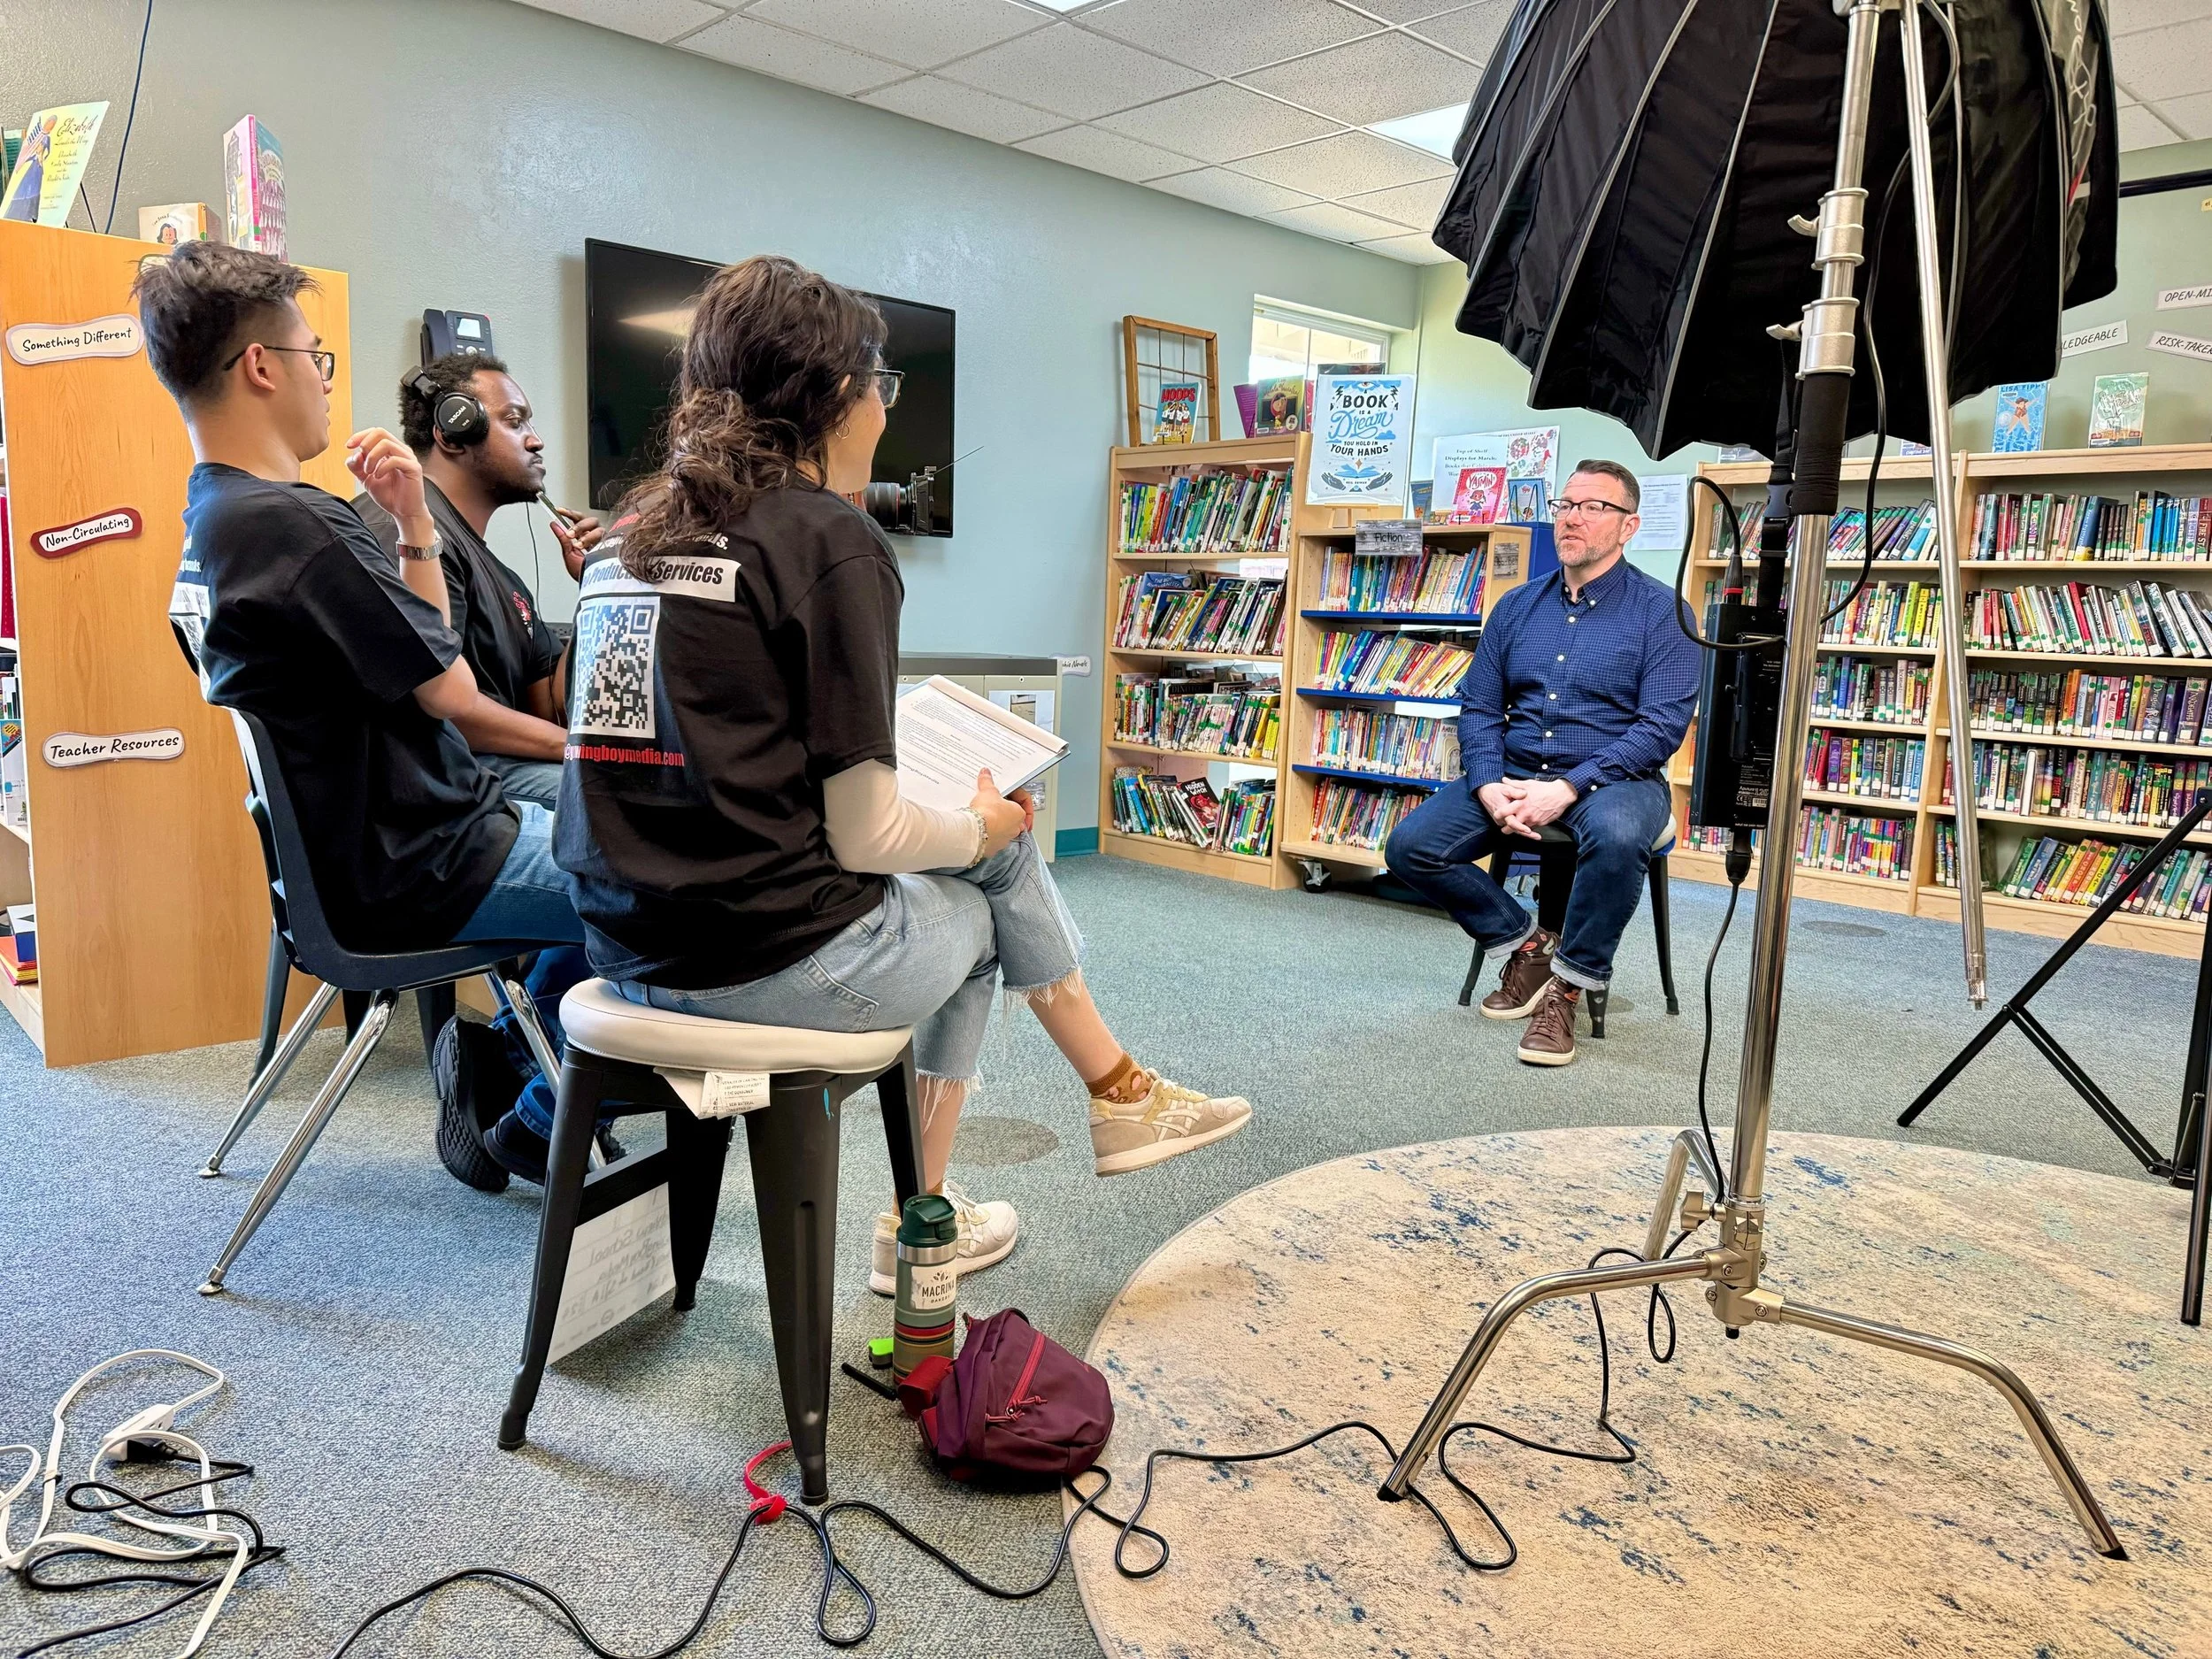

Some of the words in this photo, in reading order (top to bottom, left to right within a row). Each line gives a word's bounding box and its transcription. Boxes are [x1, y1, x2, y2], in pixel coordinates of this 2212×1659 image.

[2164, 288, 2212, 303] OPEN-MI
[22, 335, 81, 353] Something
[83, 327, 132, 346] Different
[2062, 328, 2118, 350] LEDGEABLE
[1161, 388, 1195, 403] HOOPS
[1342, 395, 1389, 409] BOOK
[448, 405, 466, 425] TASCAM
[1328, 409, 1394, 439] Dream
[1330, 443, 1354, 457] YOUR
[1357, 444, 1389, 457] HANDS
[45, 518, 130, 549] Non-Circulating
[1374, 532, 1403, 542] Fiction
[653, 560, 724, 585] Services
[50, 741, 107, 759] Teacher
[111, 735, 180, 754] Resources
